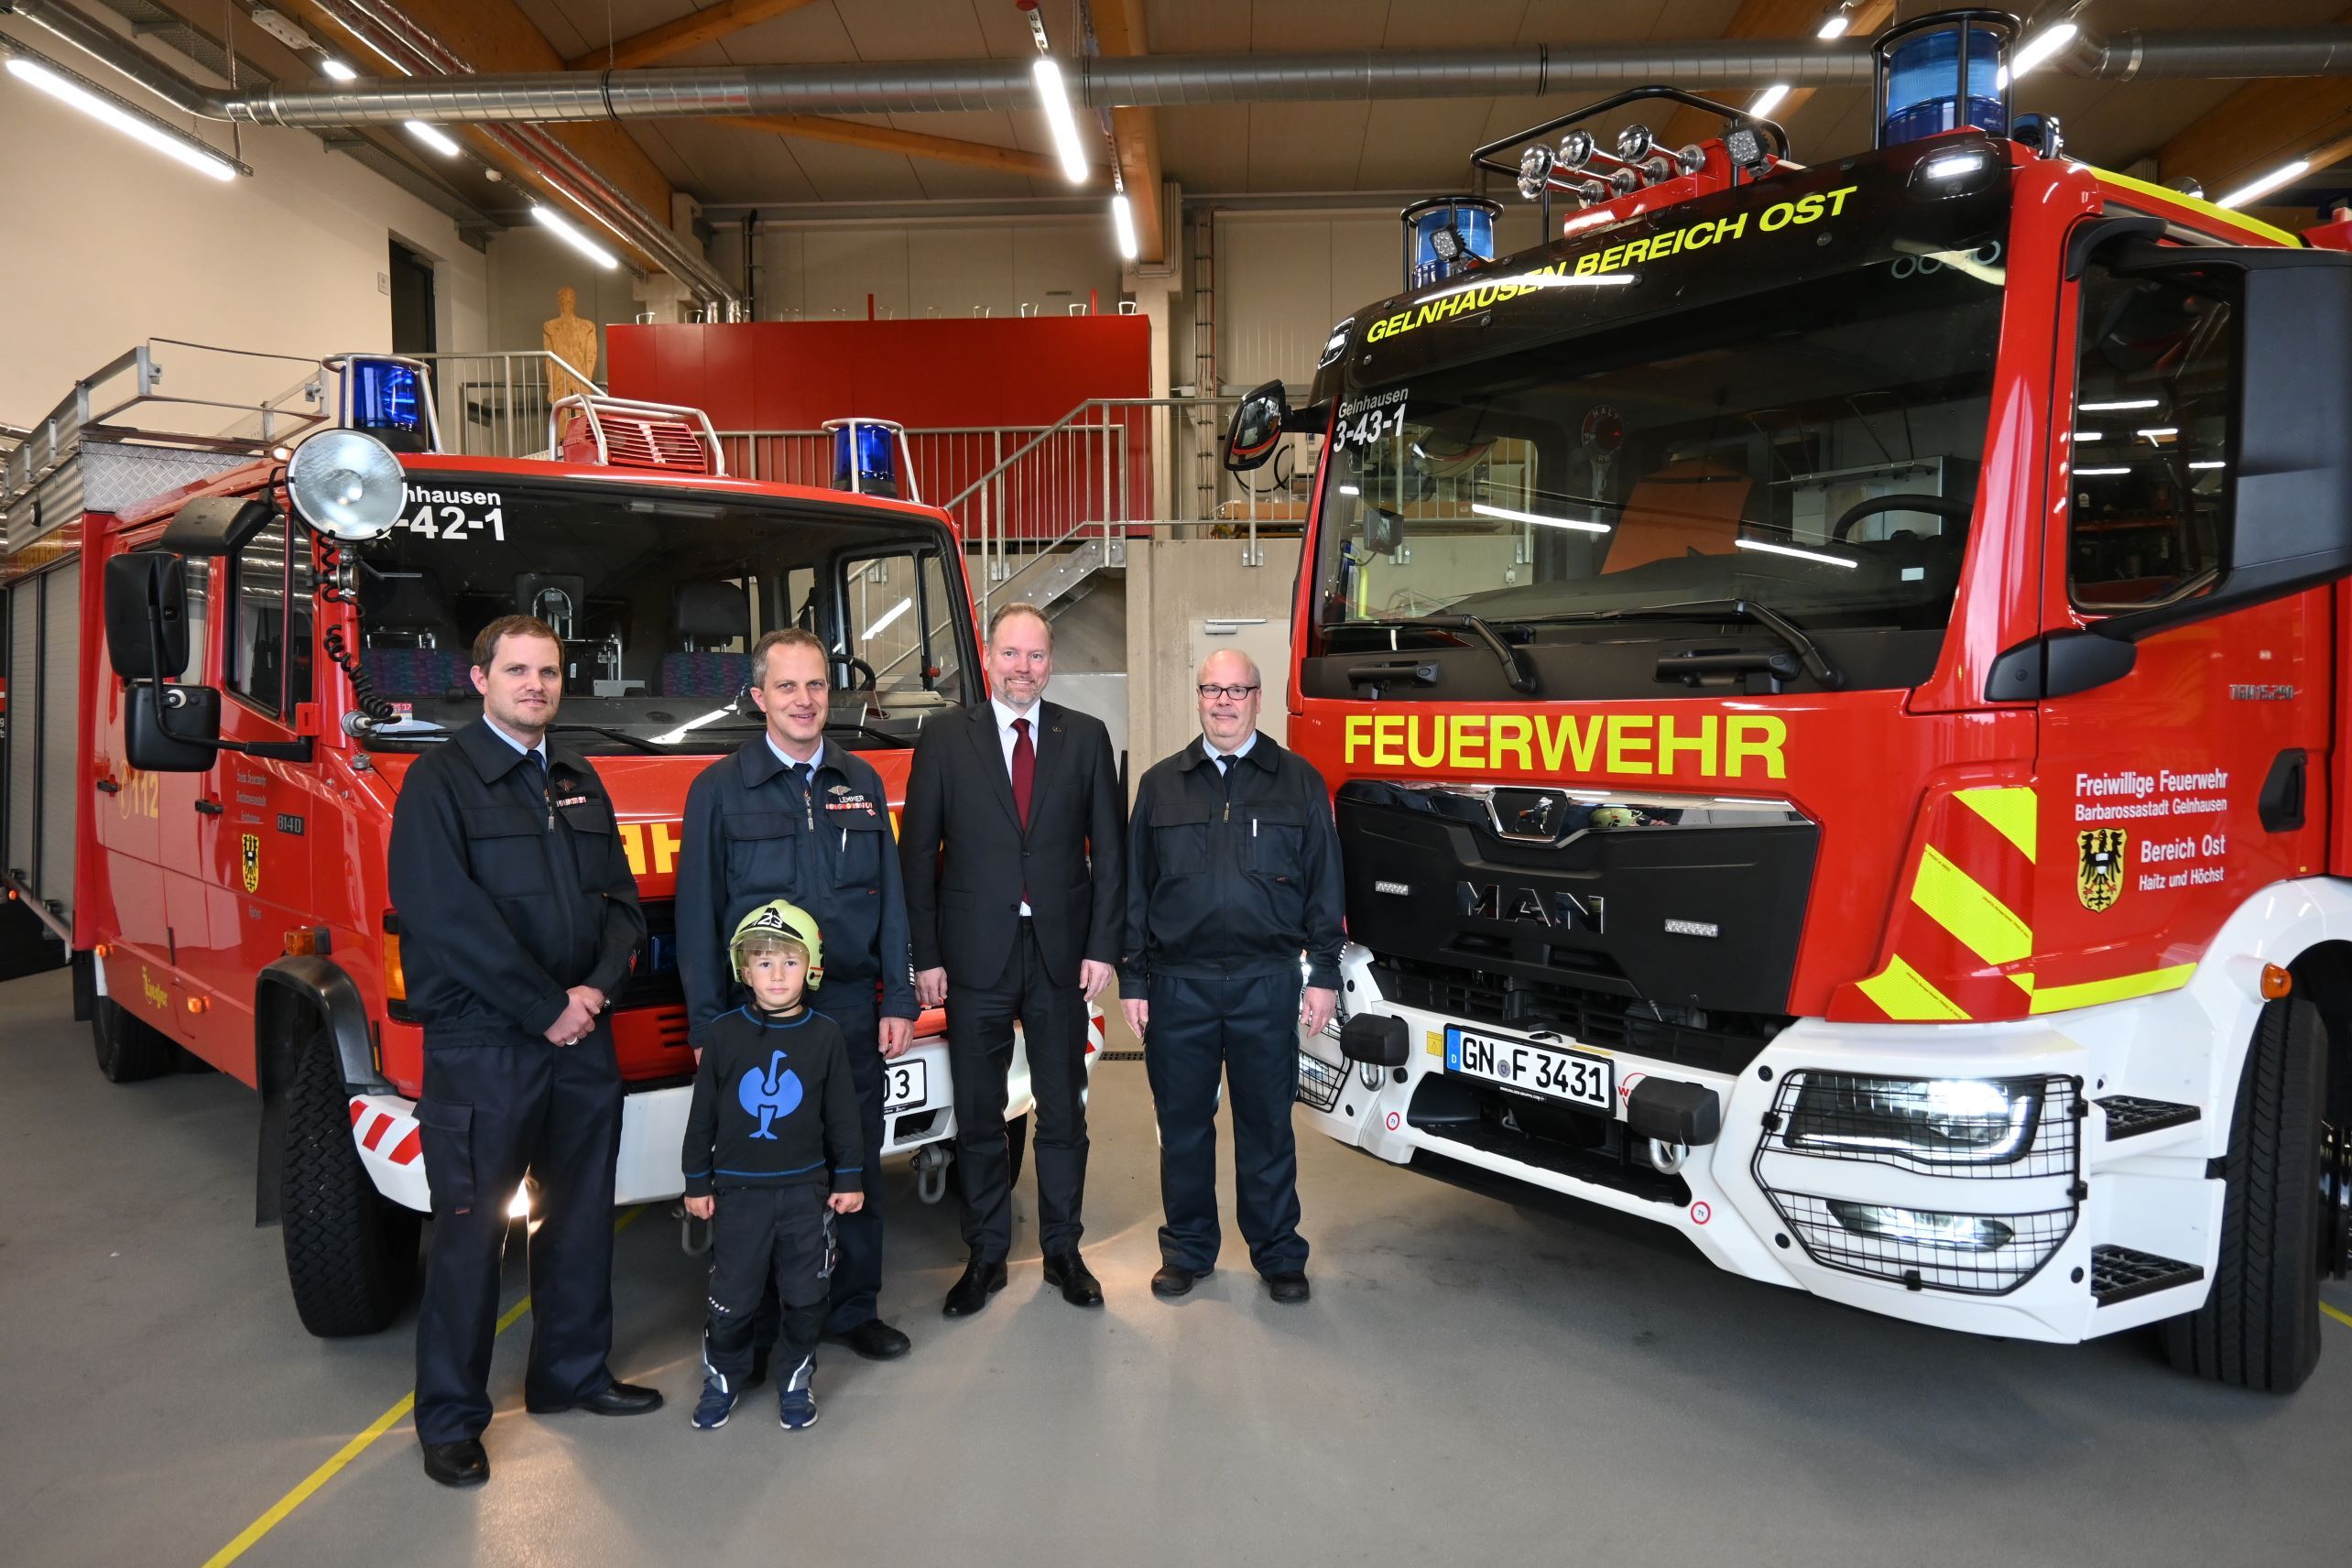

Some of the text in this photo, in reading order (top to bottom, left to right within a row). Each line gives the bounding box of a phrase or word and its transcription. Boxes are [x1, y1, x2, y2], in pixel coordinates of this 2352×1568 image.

[1367, 186, 1857, 344] GELNHAUSEN BEREICH OST
[1338, 388, 1409, 419] Gelnhausen
[1333, 403, 1406, 452] 3-43-1
[408, 485, 501, 506] nhausen
[376, 505, 505, 541] -42-1
[1345, 715, 1786, 779] FEUERWEHR
[2076, 768, 2228, 799] Freiwillige Feuerwehr
[2075, 798, 2227, 821] Barbarossastadt Gelnhausen
[2140, 834, 2226, 863] Bereich Ost
[2139, 866, 2225, 891] Haitz und Höchst
[1457, 881, 1605, 934] MAN
[1451, 1054, 1457, 1063] D
[1462, 1037, 1495, 1075] GN
[1512, 1049, 1529, 1082] F
[1535, 1053, 1606, 1104] 3431
